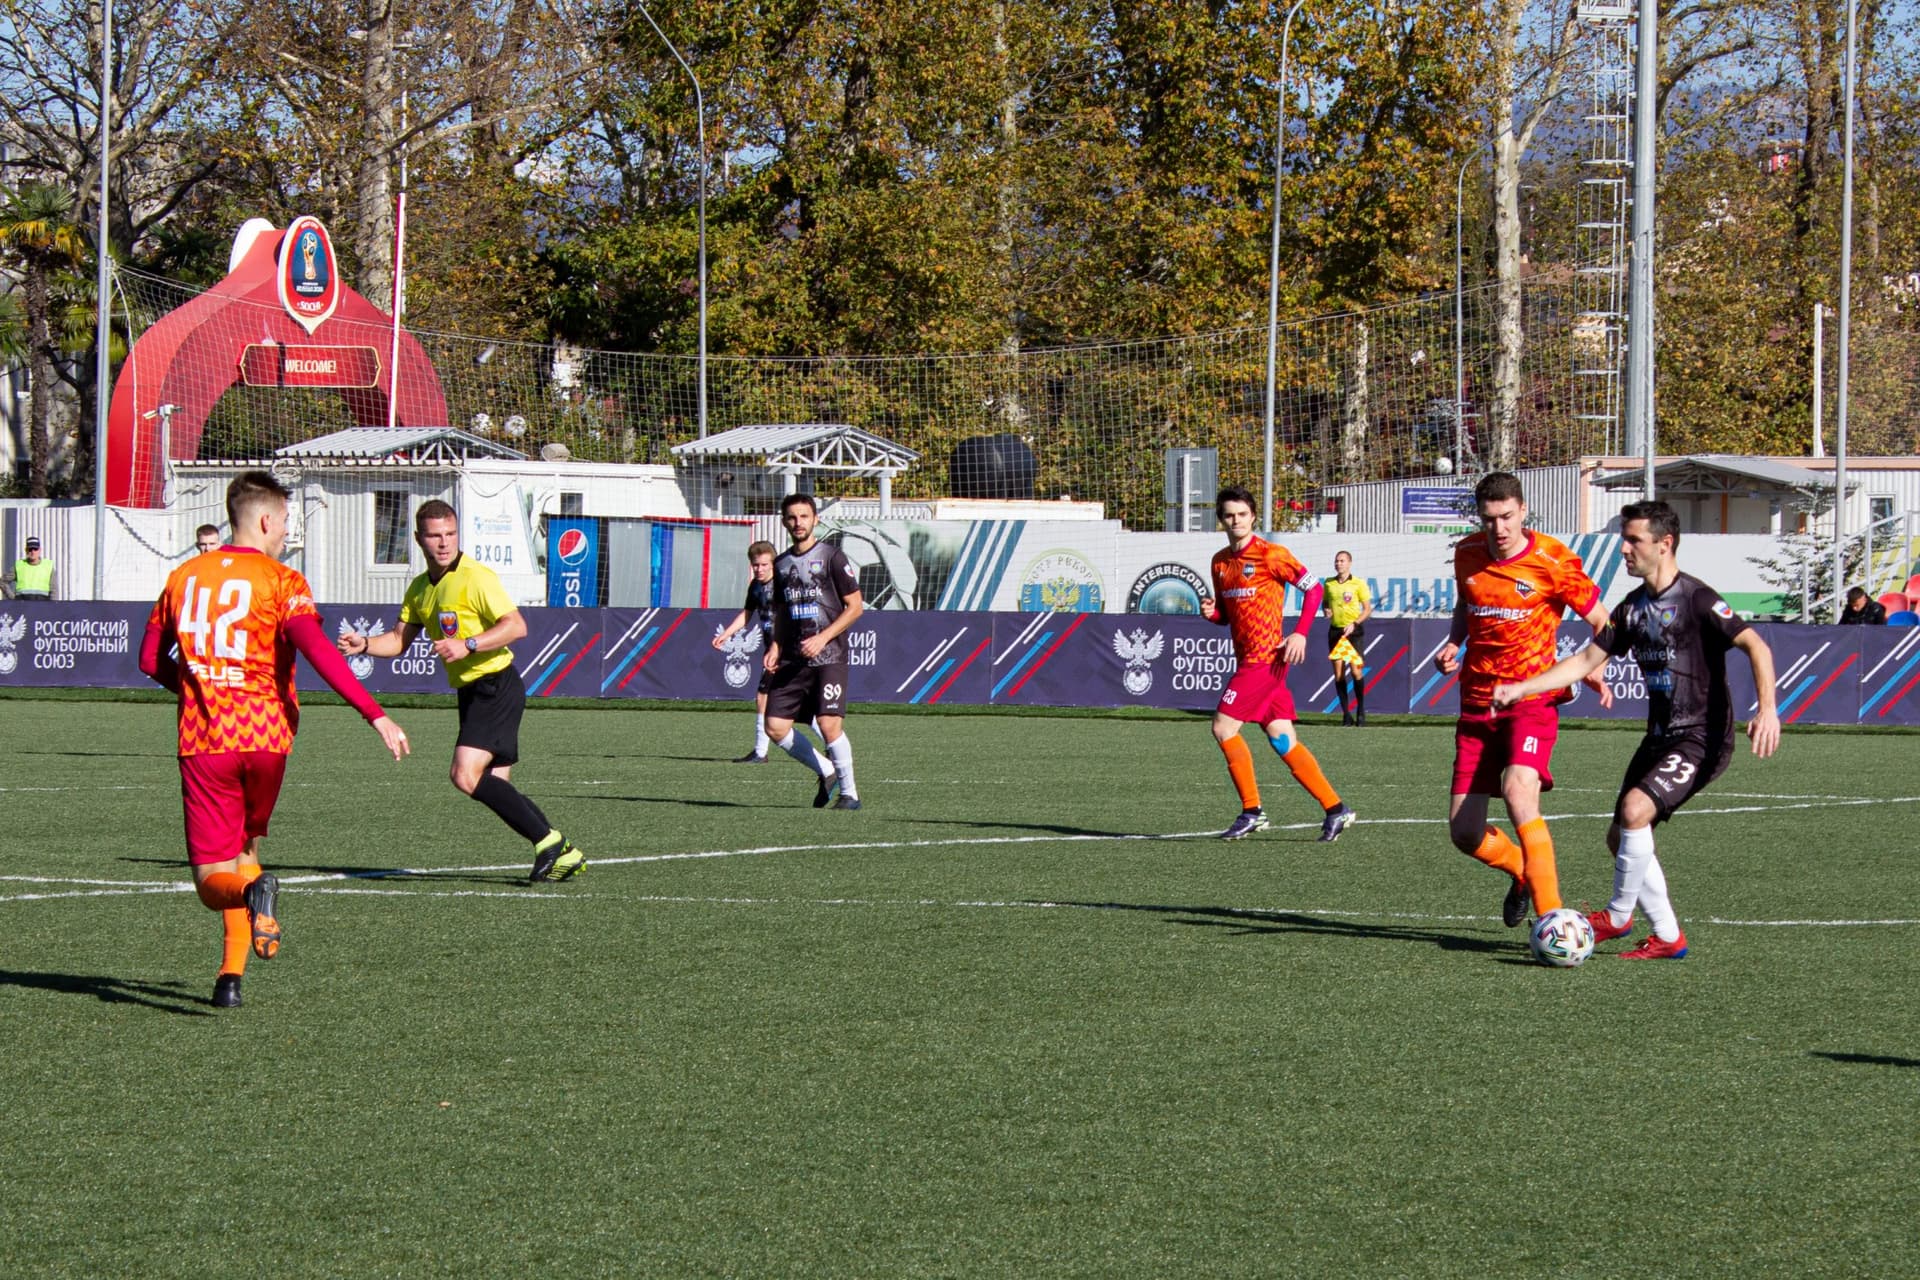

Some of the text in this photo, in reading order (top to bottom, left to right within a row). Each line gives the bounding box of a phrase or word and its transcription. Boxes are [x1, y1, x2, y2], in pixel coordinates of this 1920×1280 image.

[284, 359, 337, 374] WELCOME!
[475, 545, 513, 566] ВХОД
[1133, 565, 1207, 596] INTERRECORD
[34, 618, 129, 636] РОССИЙСКИЙ
[178, 575, 252, 661] 42
[33, 636, 129, 653] ФУТБОЛЬНЫЙ
[33, 653, 75, 669] СОЮЗ
[391, 658, 436, 675] СОЮЗ
[1172, 673, 1222, 691] СОЮЗ
[1605, 681, 1650, 700] ОЮ
[823, 683, 842, 701] 89
[1222, 688, 1238, 705] 23
[1522, 735, 1539, 755] 21
[1659, 753, 1696, 785] 33
